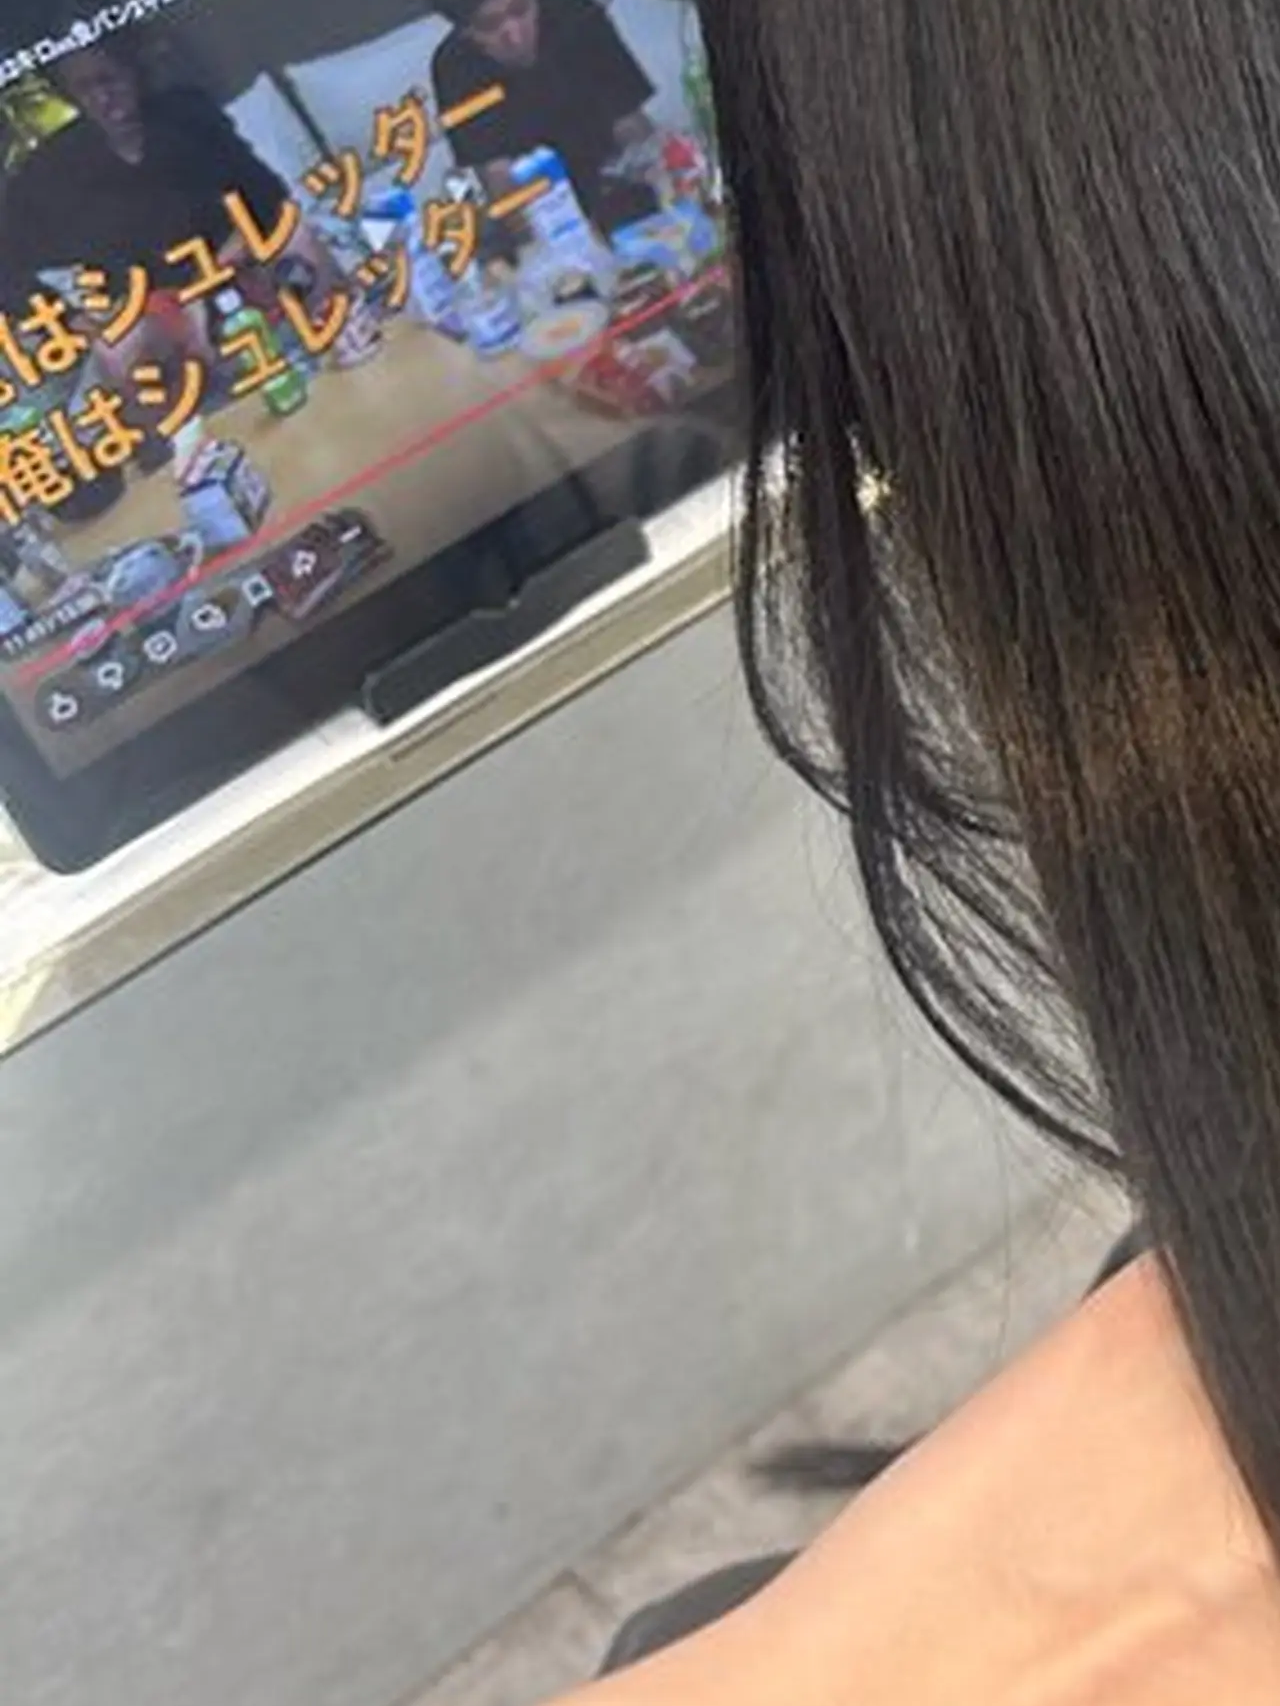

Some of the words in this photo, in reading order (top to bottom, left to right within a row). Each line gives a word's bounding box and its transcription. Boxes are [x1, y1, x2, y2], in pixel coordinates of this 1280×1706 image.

[0, 85, 505, 406] はシュレッダー
